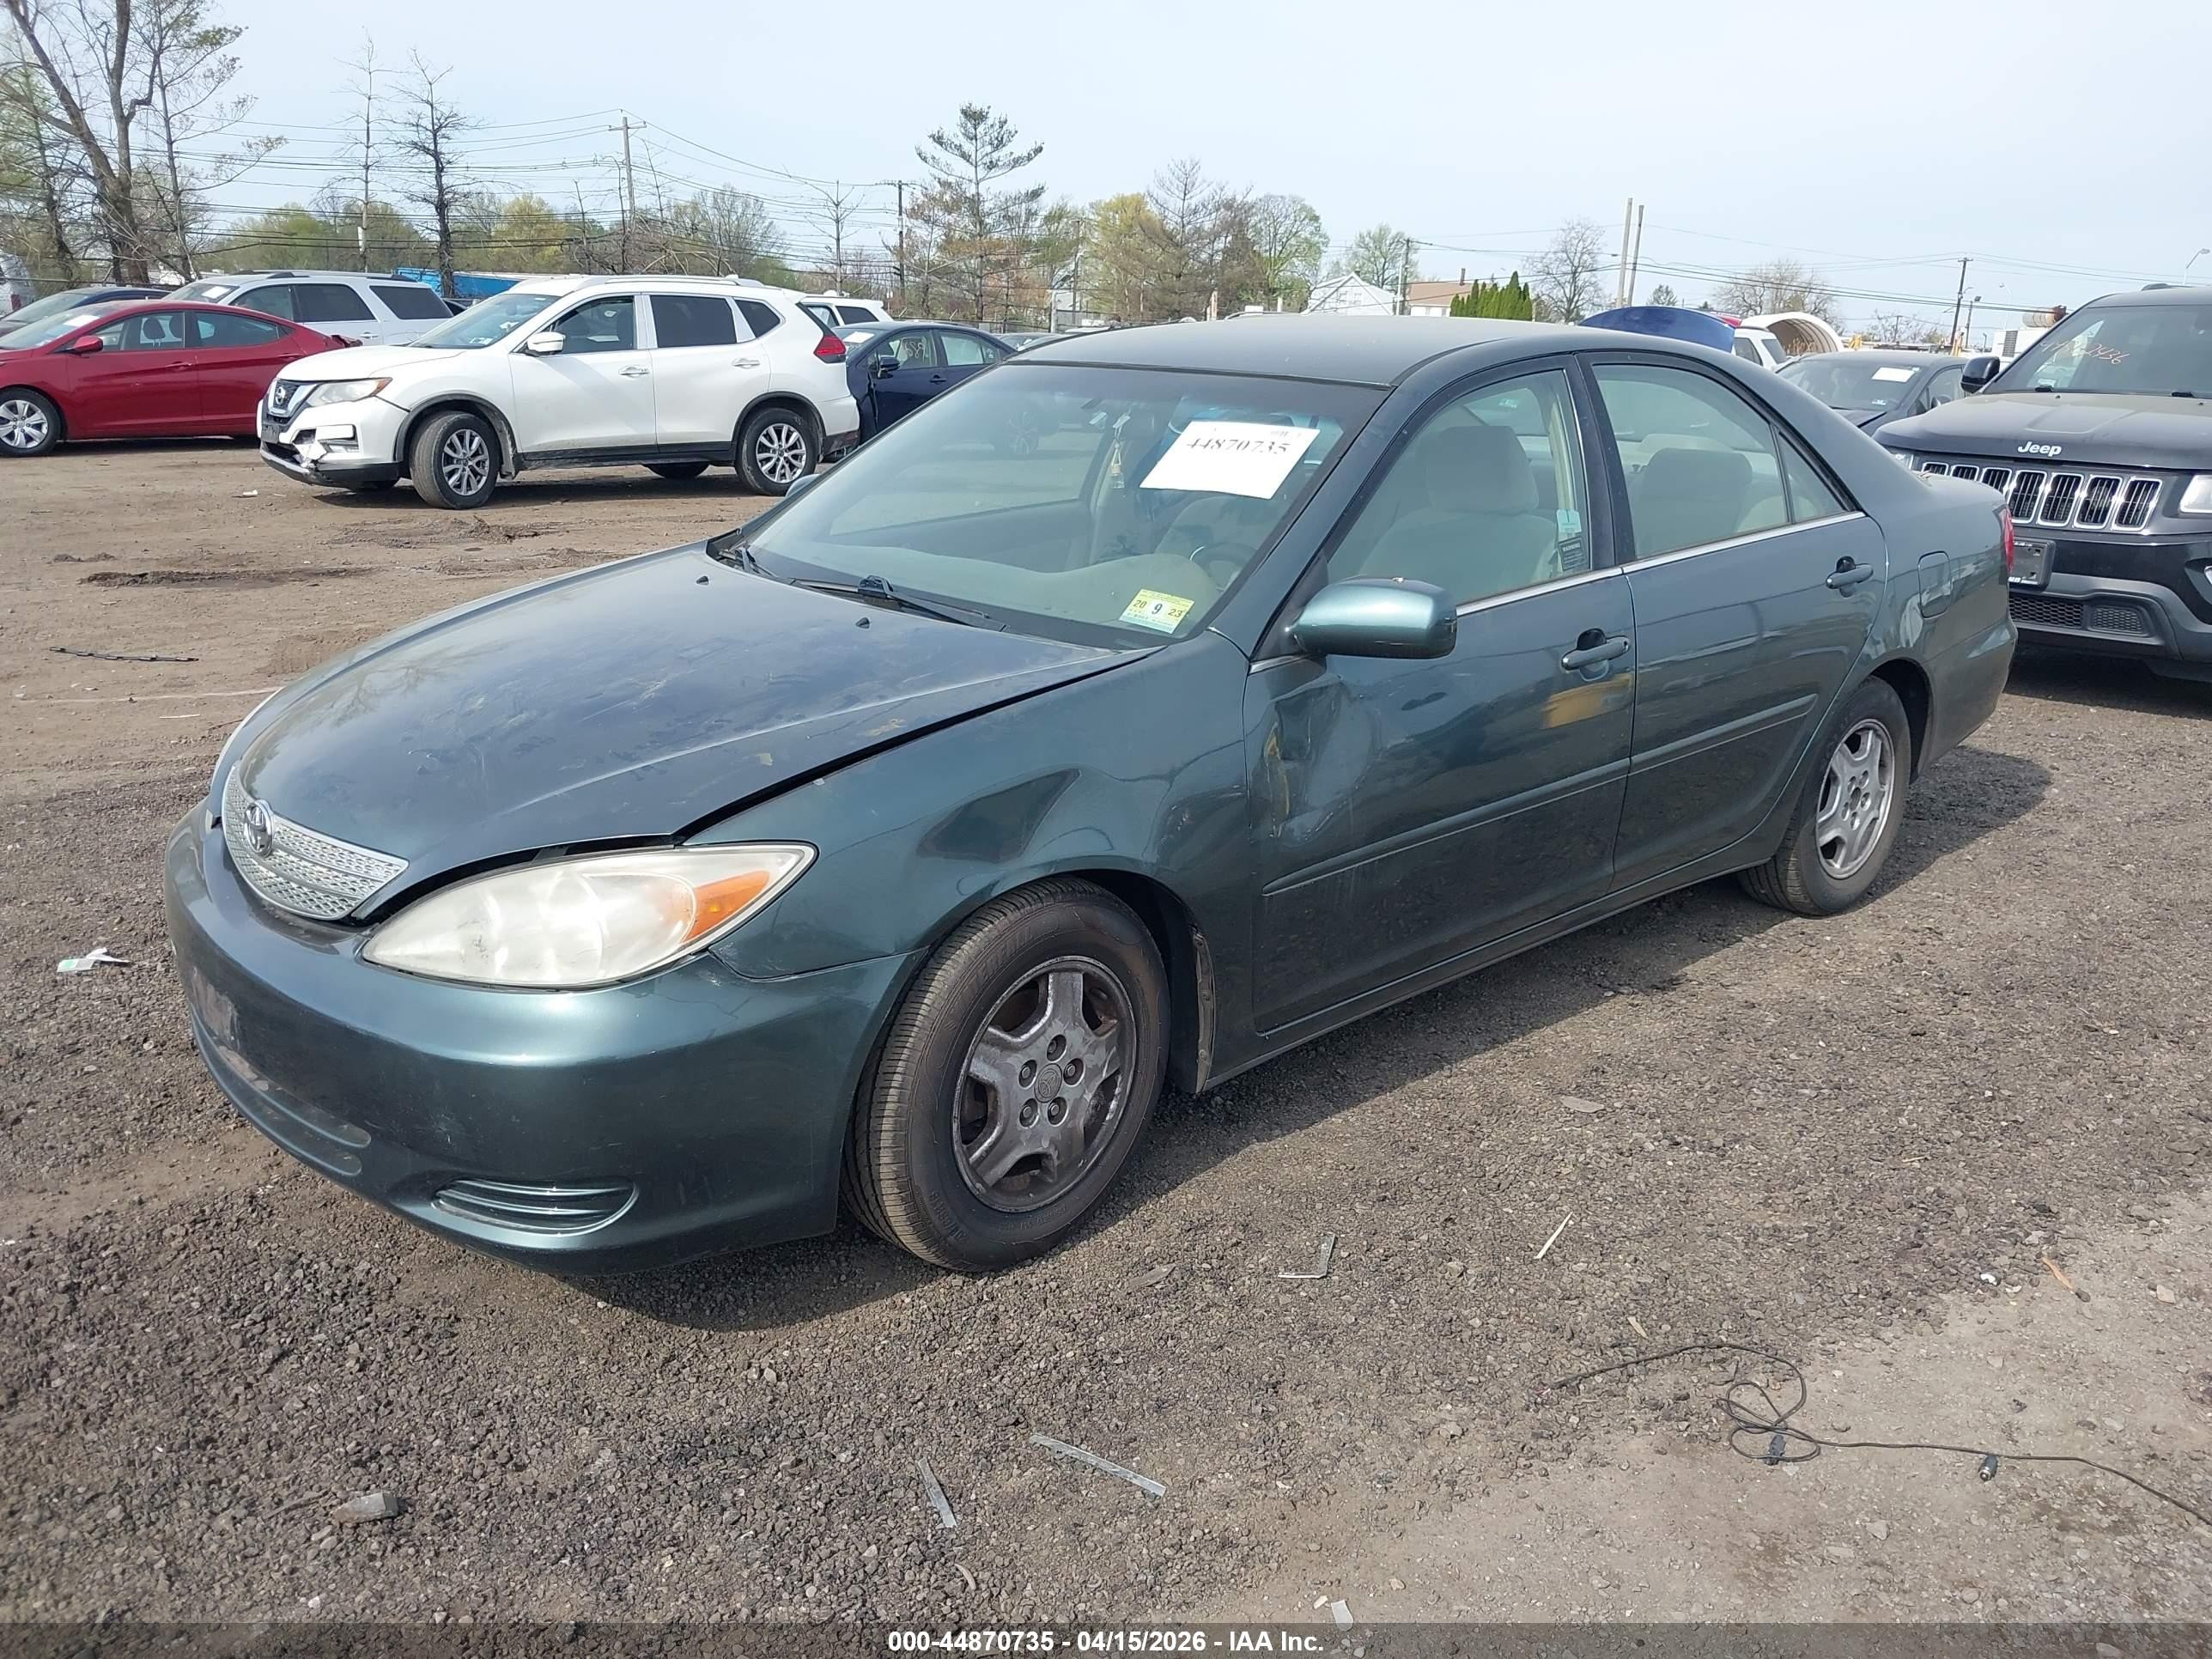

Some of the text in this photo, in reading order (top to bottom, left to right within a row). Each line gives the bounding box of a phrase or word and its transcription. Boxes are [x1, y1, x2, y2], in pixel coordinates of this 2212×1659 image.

[1186, 437, 1292, 455] 44870735
[2017, 441, 2062, 458] Jeep
[1133, 599, 1184, 618] 20 9 23
